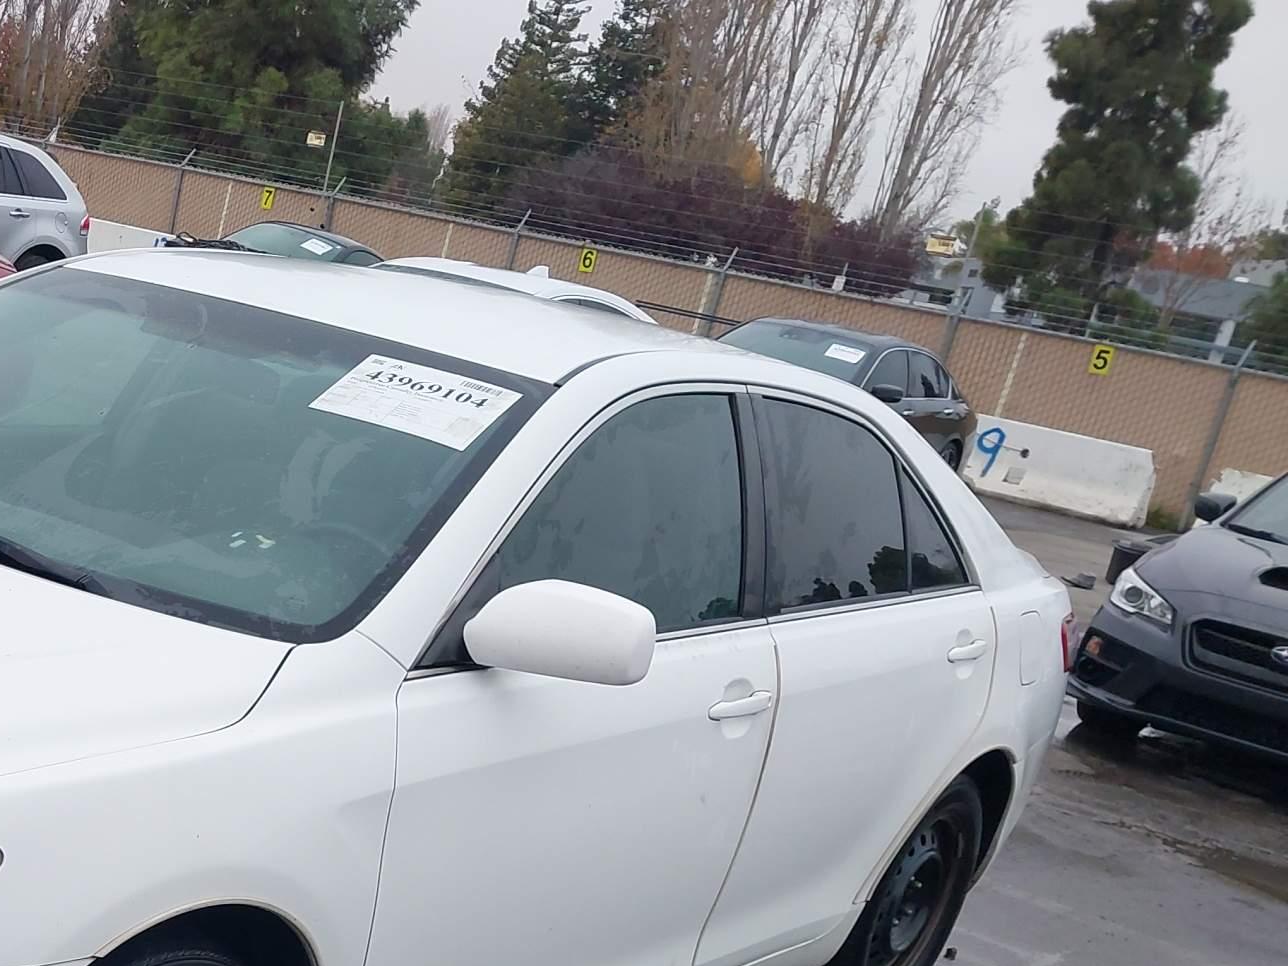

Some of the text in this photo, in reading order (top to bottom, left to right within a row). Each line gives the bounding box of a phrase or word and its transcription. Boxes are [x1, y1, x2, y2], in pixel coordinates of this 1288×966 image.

[264, 190, 273, 206] 7
[582, 250, 594, 269] 6
[1093, 349, 1111, 370] 5
[365, 370, 490, 409] 43969104
[977, 427, 1006, 478] 9
